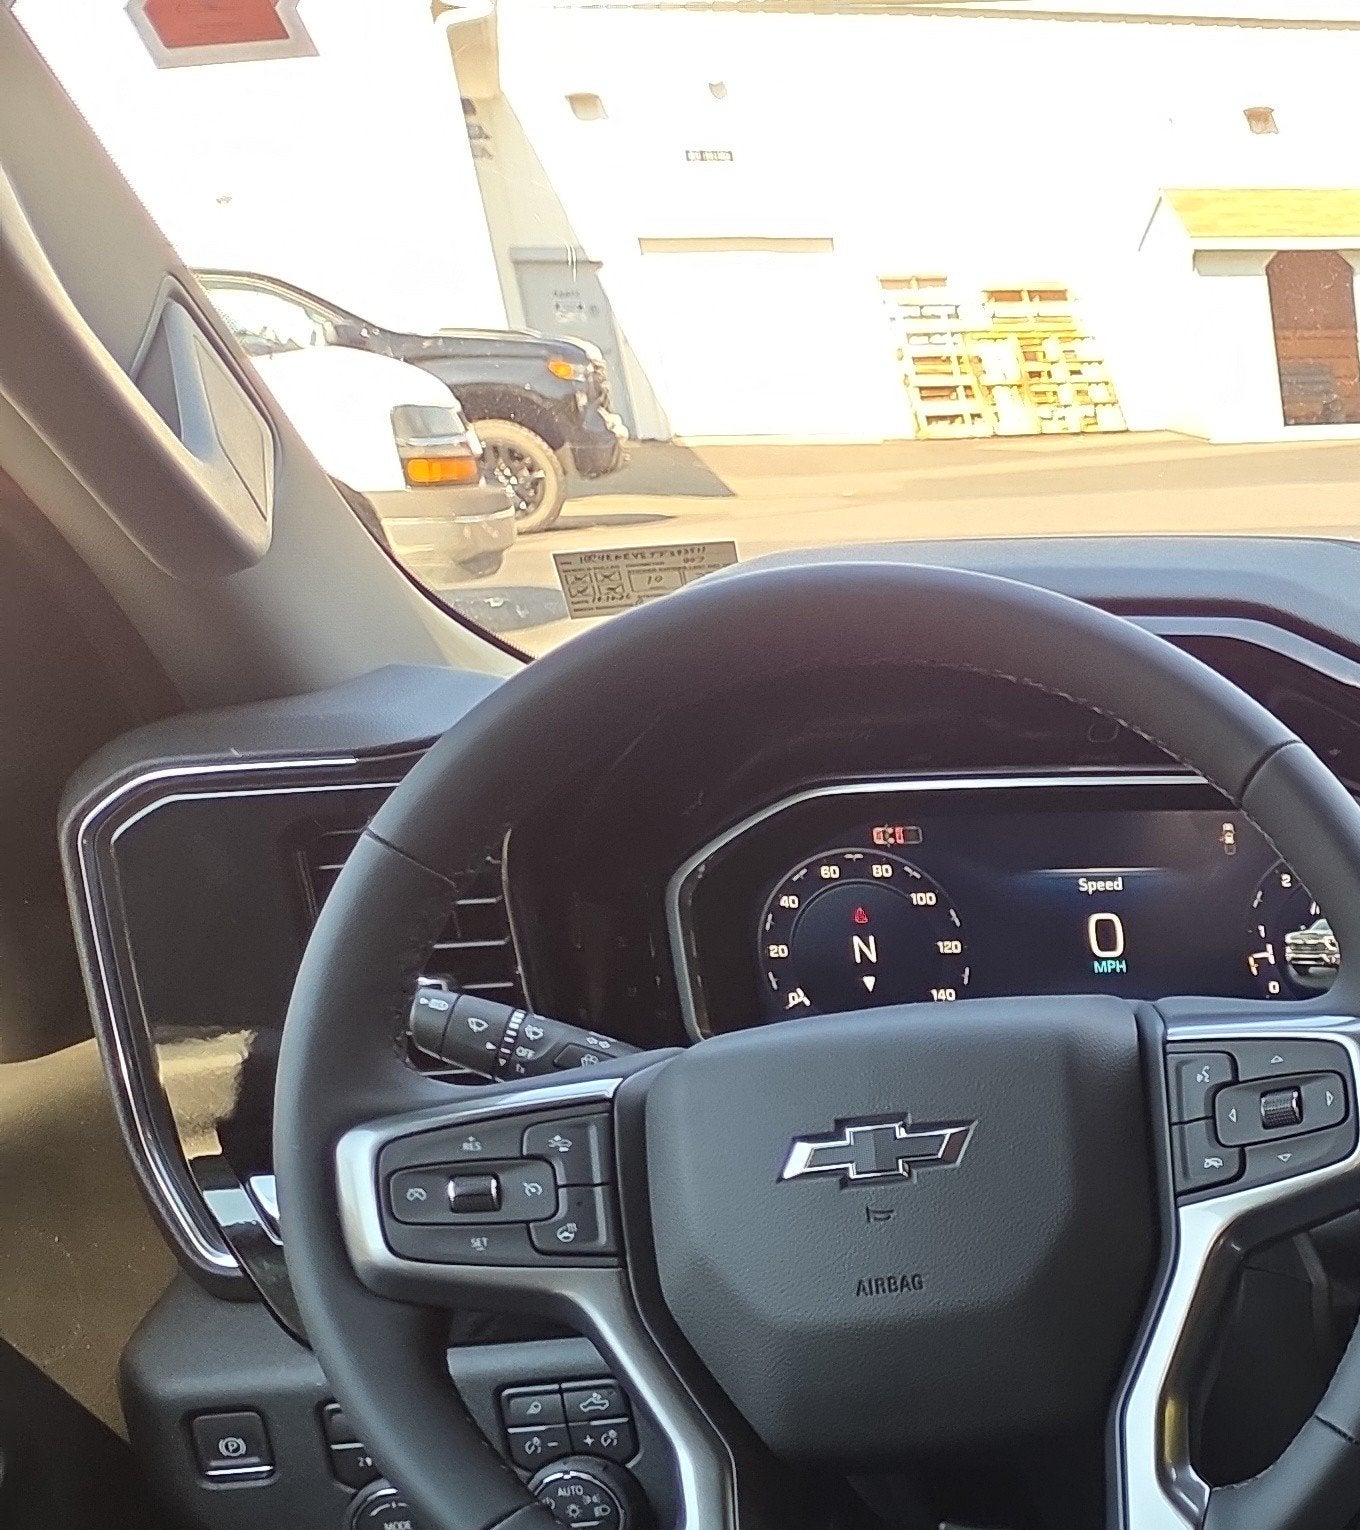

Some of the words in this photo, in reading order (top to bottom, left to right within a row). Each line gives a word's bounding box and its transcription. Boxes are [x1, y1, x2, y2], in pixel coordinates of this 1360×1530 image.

[820, 865, 840, 879] 60
[871, 864, 893, 878] 80
[1078, 877, 1123, 895] Speed
[1281, 873, 1291, 887] 2
[779, 895, 799, 909] 40
[910, 892, 937, 906] 100
[1088, 912, 1125, 958] 0
[769, 945, 789, 958] 20
[852, 935, 877, 964] N
[936, 940, 962, 954] 120
[1094, 960, 1127, 974] MPH
[931, 988, 956, 1001] 140
[1268, 981, 1280, 994] 0
[856, 1273, 923, 1297] AIRBAG
[558, 1485, 584, 1496] AUTO
